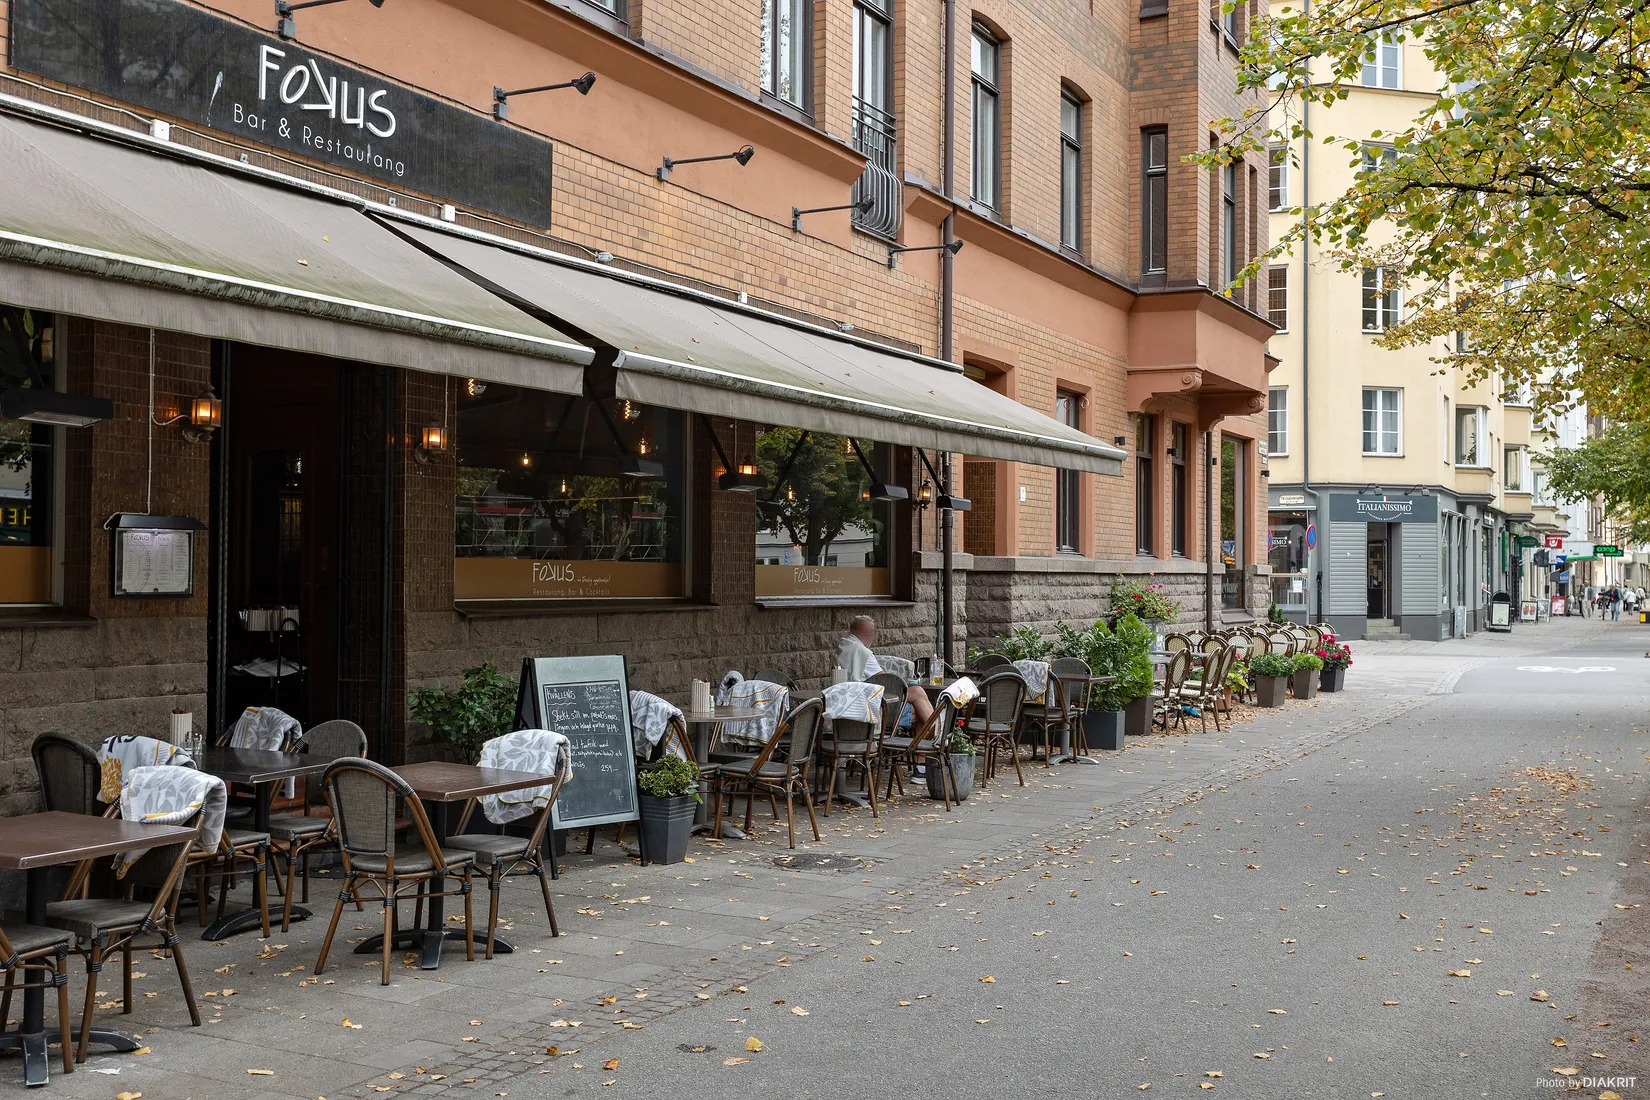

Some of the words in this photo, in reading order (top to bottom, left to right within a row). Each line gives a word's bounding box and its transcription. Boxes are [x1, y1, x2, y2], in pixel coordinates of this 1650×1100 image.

[233, 103, 267, 131] Bar
[278, 117, 291, 139] &
[302, 125, 405, 177] Restaurang
[1358, 503, 1412, 512] ITALIANISSIMO
[579, 588, 584, 596] &
